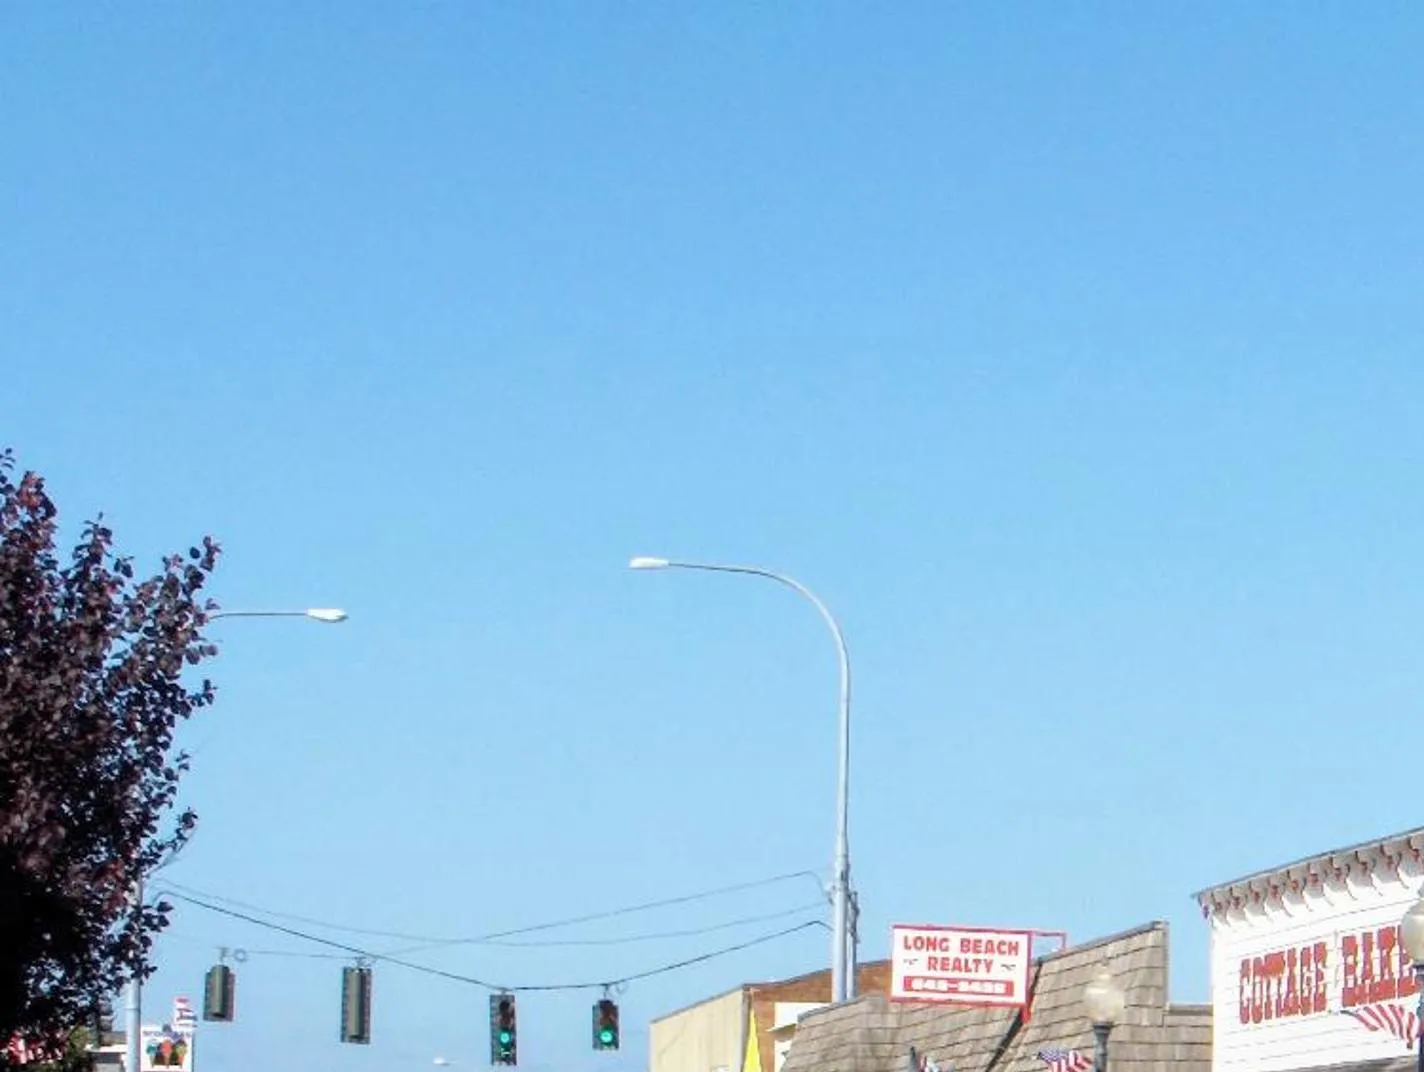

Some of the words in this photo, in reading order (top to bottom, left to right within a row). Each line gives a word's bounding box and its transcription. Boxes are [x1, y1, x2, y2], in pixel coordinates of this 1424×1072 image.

[903, 936, 950, 952] LONG
[960, 938, 1020, 956] BEACH
[928, 956, 994, 973] REALTY
[1240, 942, 1328, 1025] COTTAGE
